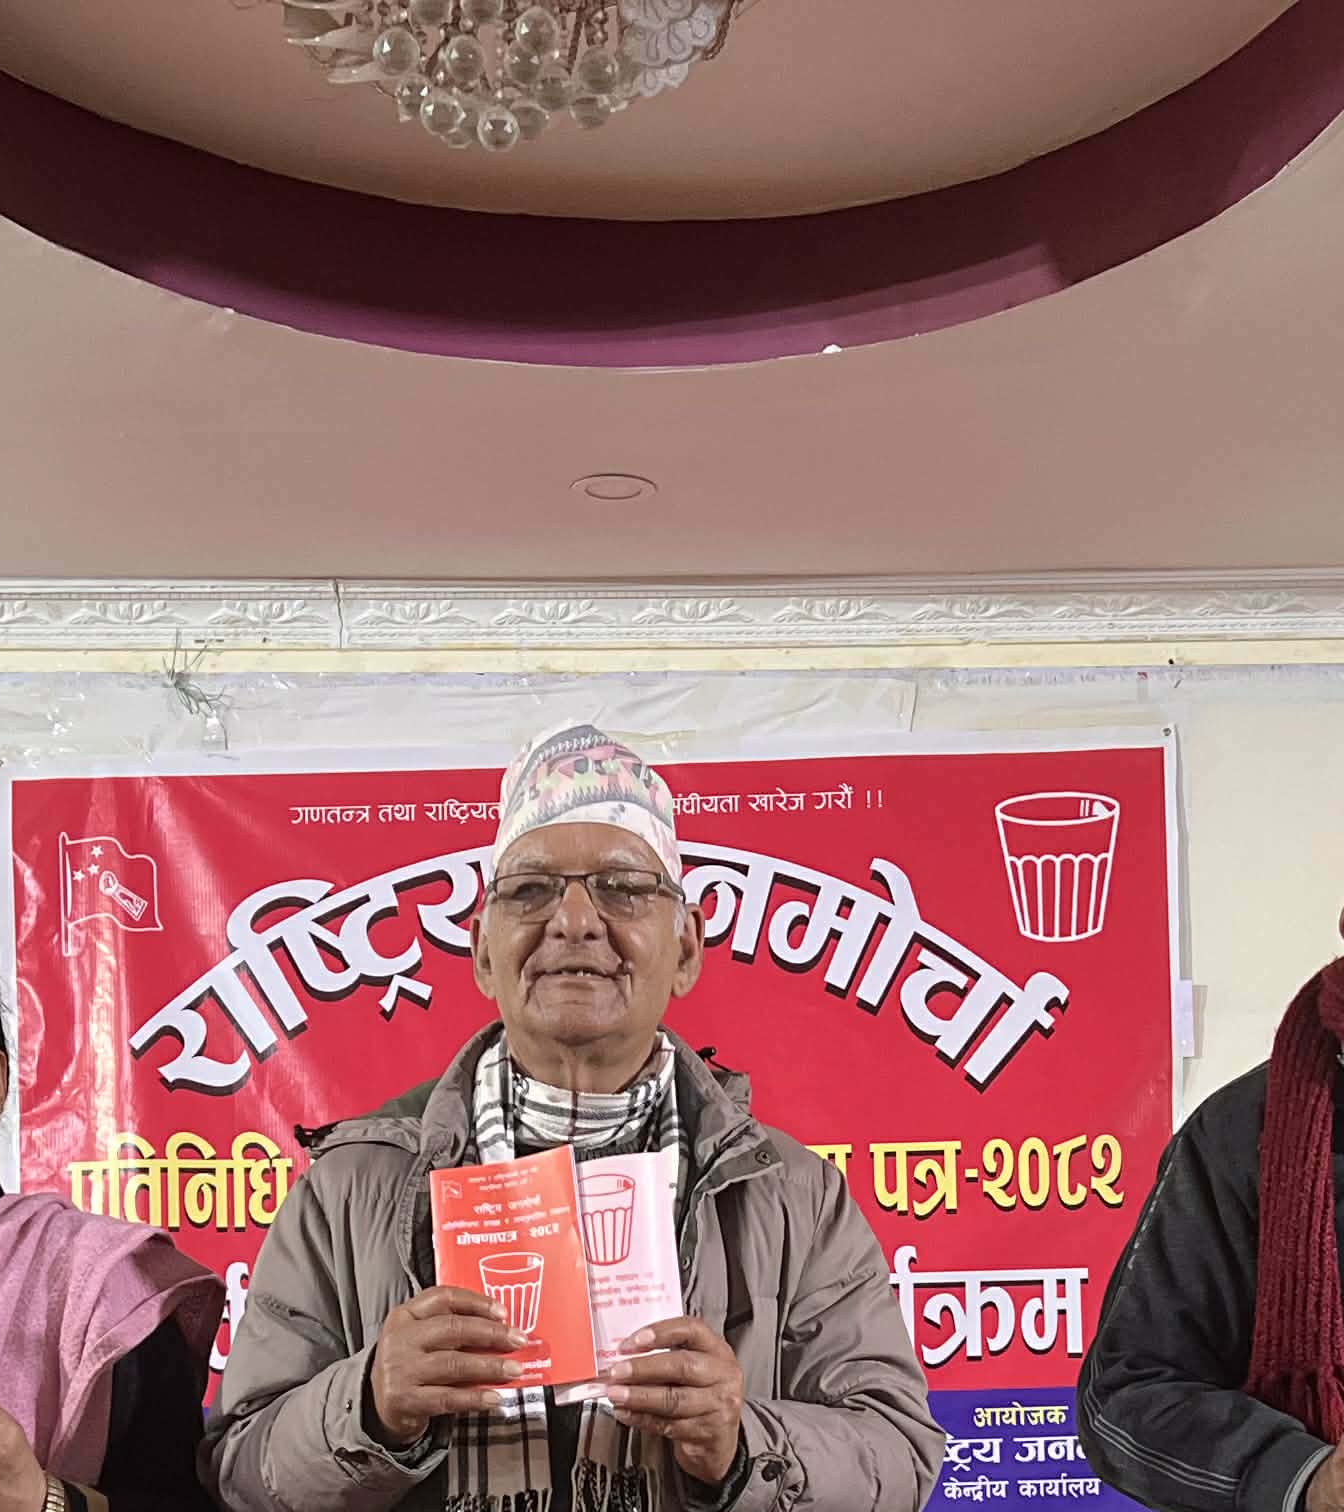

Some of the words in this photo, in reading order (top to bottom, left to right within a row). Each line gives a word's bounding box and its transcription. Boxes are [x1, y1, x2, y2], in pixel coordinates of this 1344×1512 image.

[289, 805, 371, 825] गणतन्त्र
[377, 803, 417, 823] तथा
[747, 787, 807, 812] खारेज
[812, 783, 855, 810] गरौं
[130, 844, 496, 1085] राष्ट्रिय
[675, 840, 1069, 1083] नमोर्चा
[869, 1133, 1125, 1217] पत्र-२०८२
[972, 1401, 1069, 1428] आयोजक
[942, 1476, 1009, 1502] केन्द्रीय
[1017, 1473, 1102, 1499] कार्यालय
